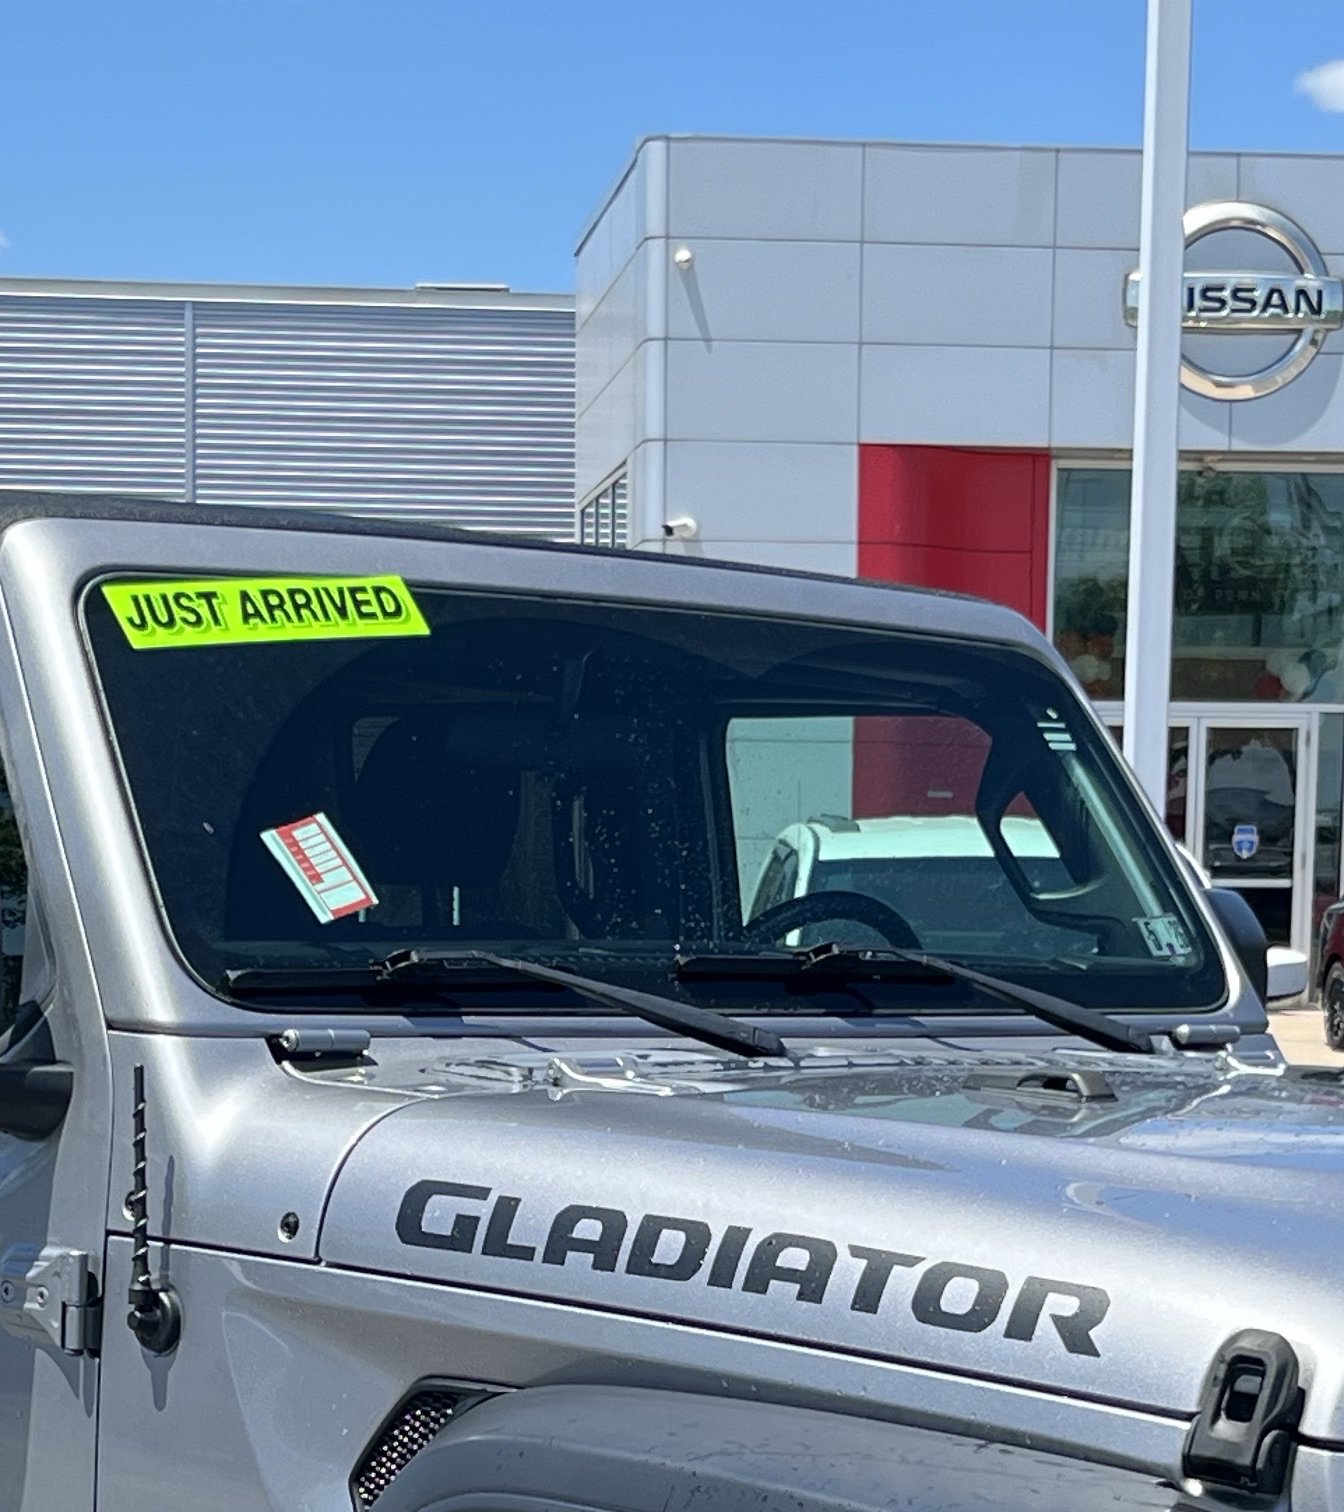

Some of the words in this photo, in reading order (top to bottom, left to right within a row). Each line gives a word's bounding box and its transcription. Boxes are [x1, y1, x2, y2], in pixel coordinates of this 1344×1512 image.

[1187, 286, 1324, 317] ISSAN
[127, 591, 225, 634] JUST
[240, 585, 407, 629] ARRIVED
[395, 1178, 1112, 1359] GLADIATOR
